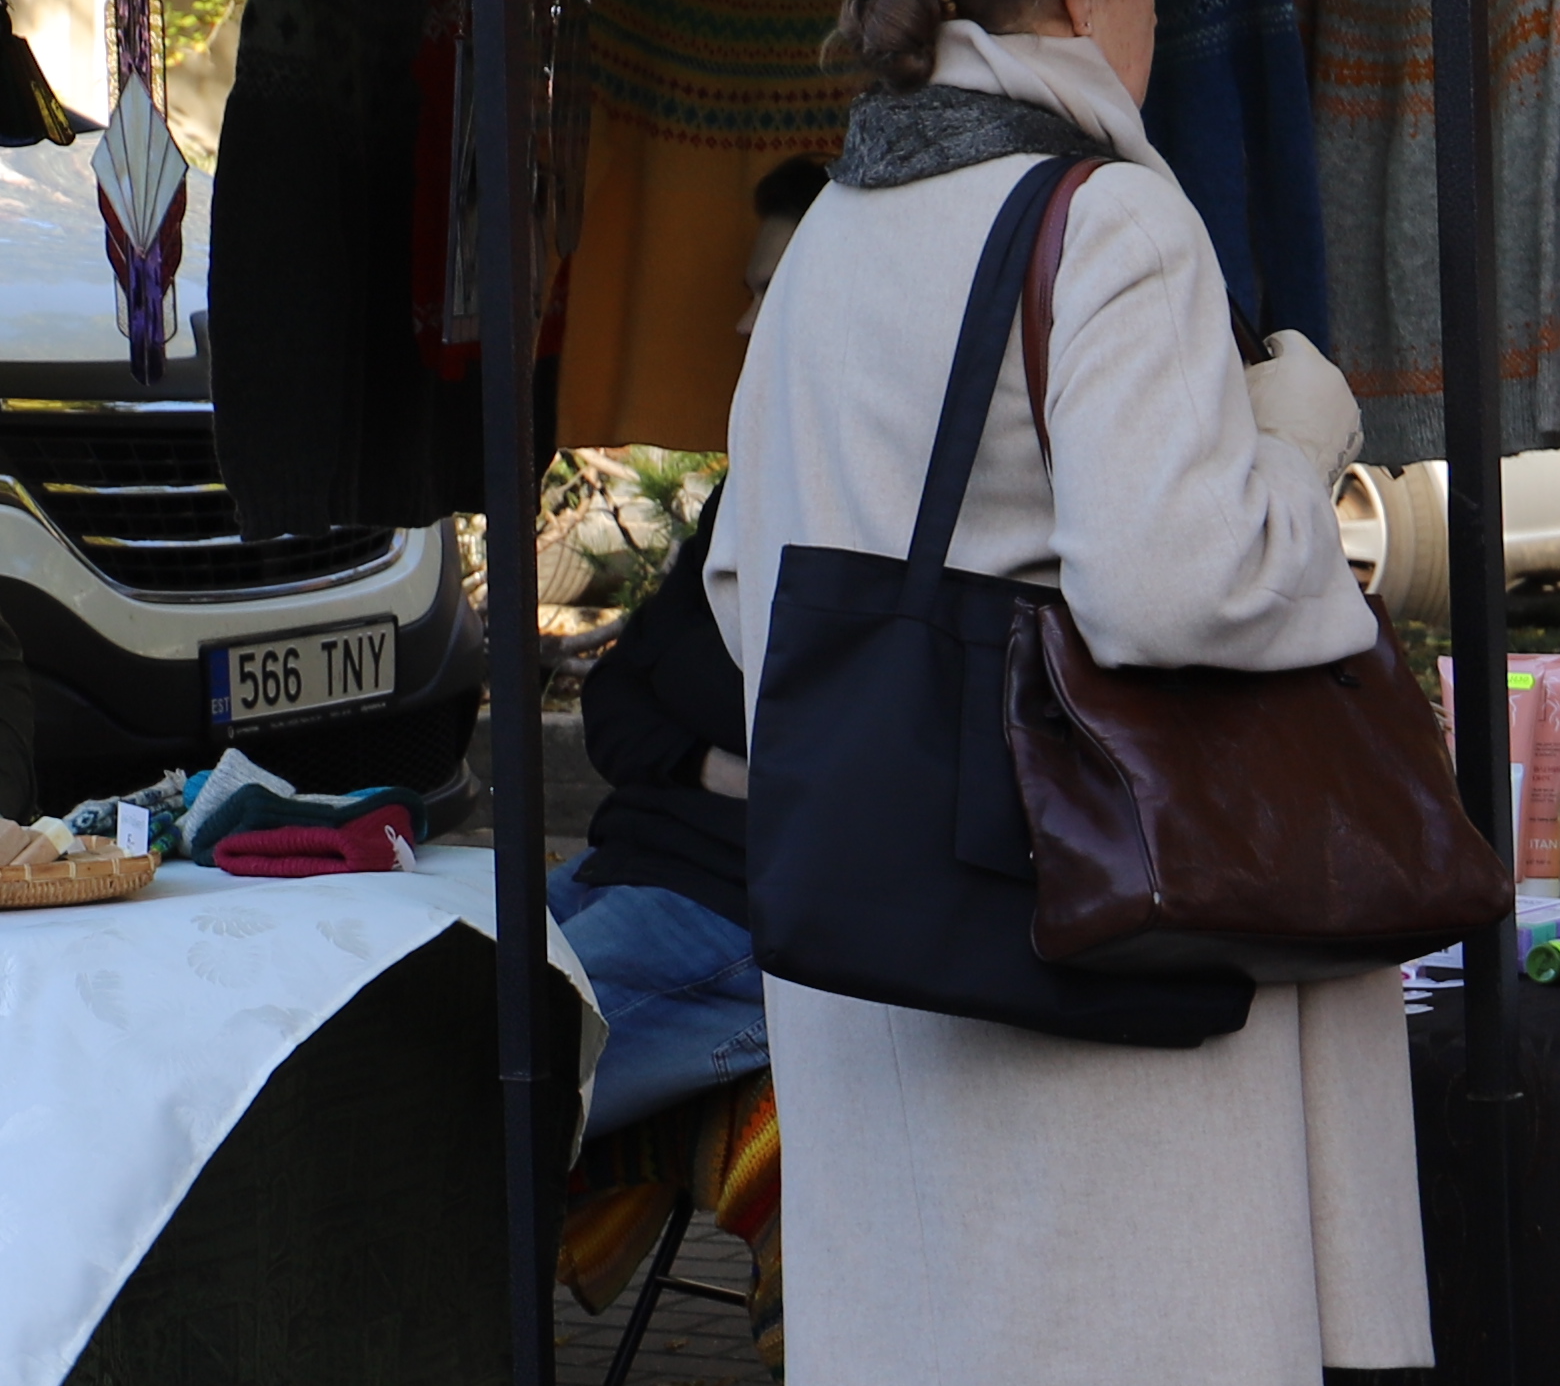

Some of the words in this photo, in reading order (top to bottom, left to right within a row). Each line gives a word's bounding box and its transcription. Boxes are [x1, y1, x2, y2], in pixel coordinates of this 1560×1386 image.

[238, 646, 303, 710] 566
[320, 630, 387, 697] TNY
[211, 696, 231, 715] EST
